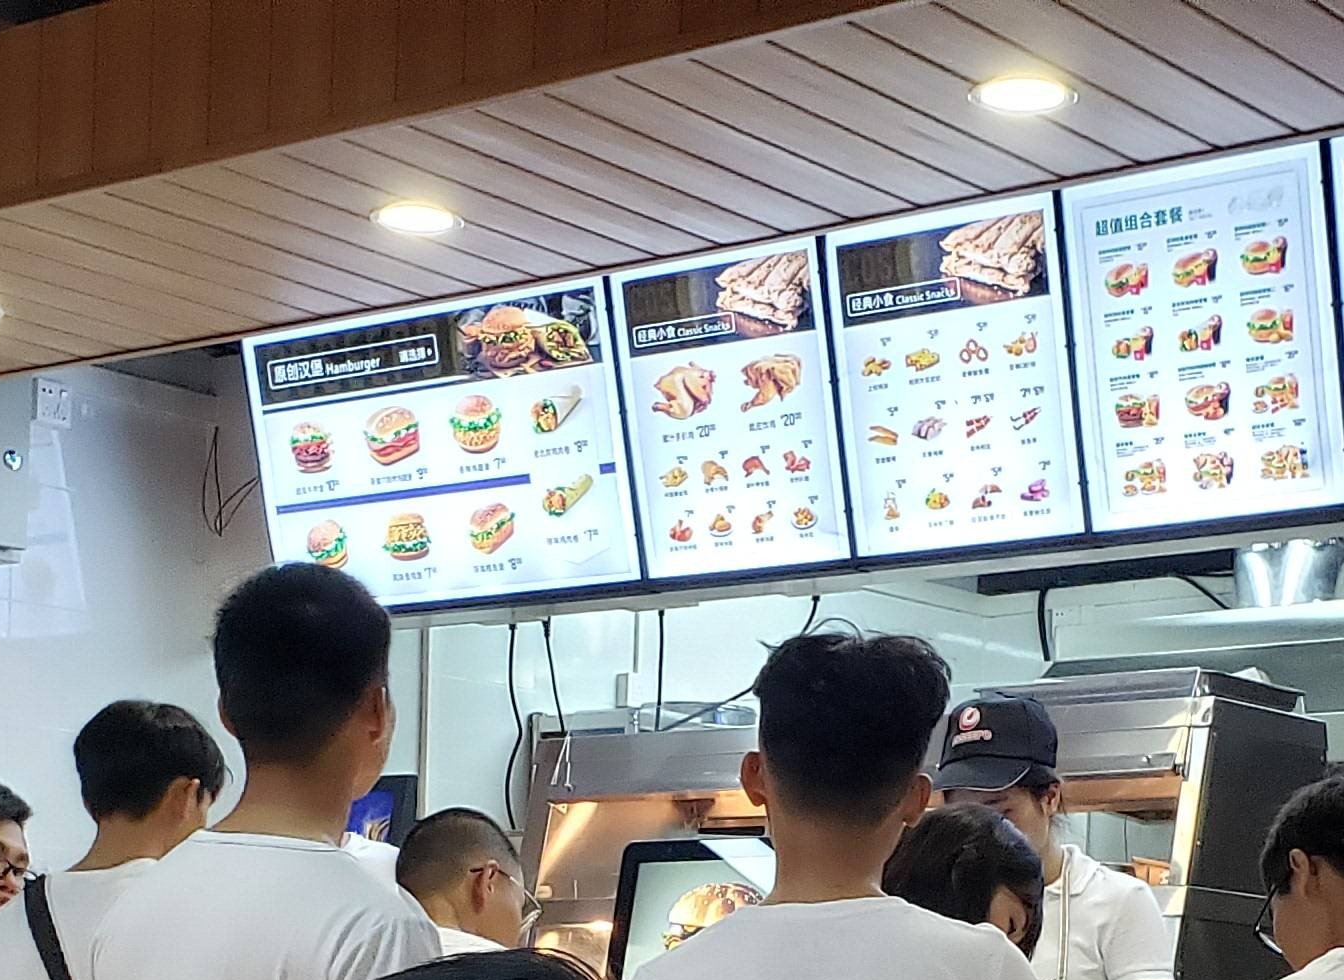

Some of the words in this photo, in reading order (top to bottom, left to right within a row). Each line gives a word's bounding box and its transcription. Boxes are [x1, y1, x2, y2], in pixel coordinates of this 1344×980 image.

[1095, 206, 1183, 236] 超值组合套餐
[851, 292, 894, 312] 经典小食
[895, 293, 924, 306] Classic
[925, 287, 955, 300] Snacks
[637, 326, 678, 343] 经典小食
[677, 325, 703, 338] Classic
[703, 321, 731, 334] Snacks
[274, 359, 324, 384] 原创汉堡
[325, 357, 381, 376] Hamburger
